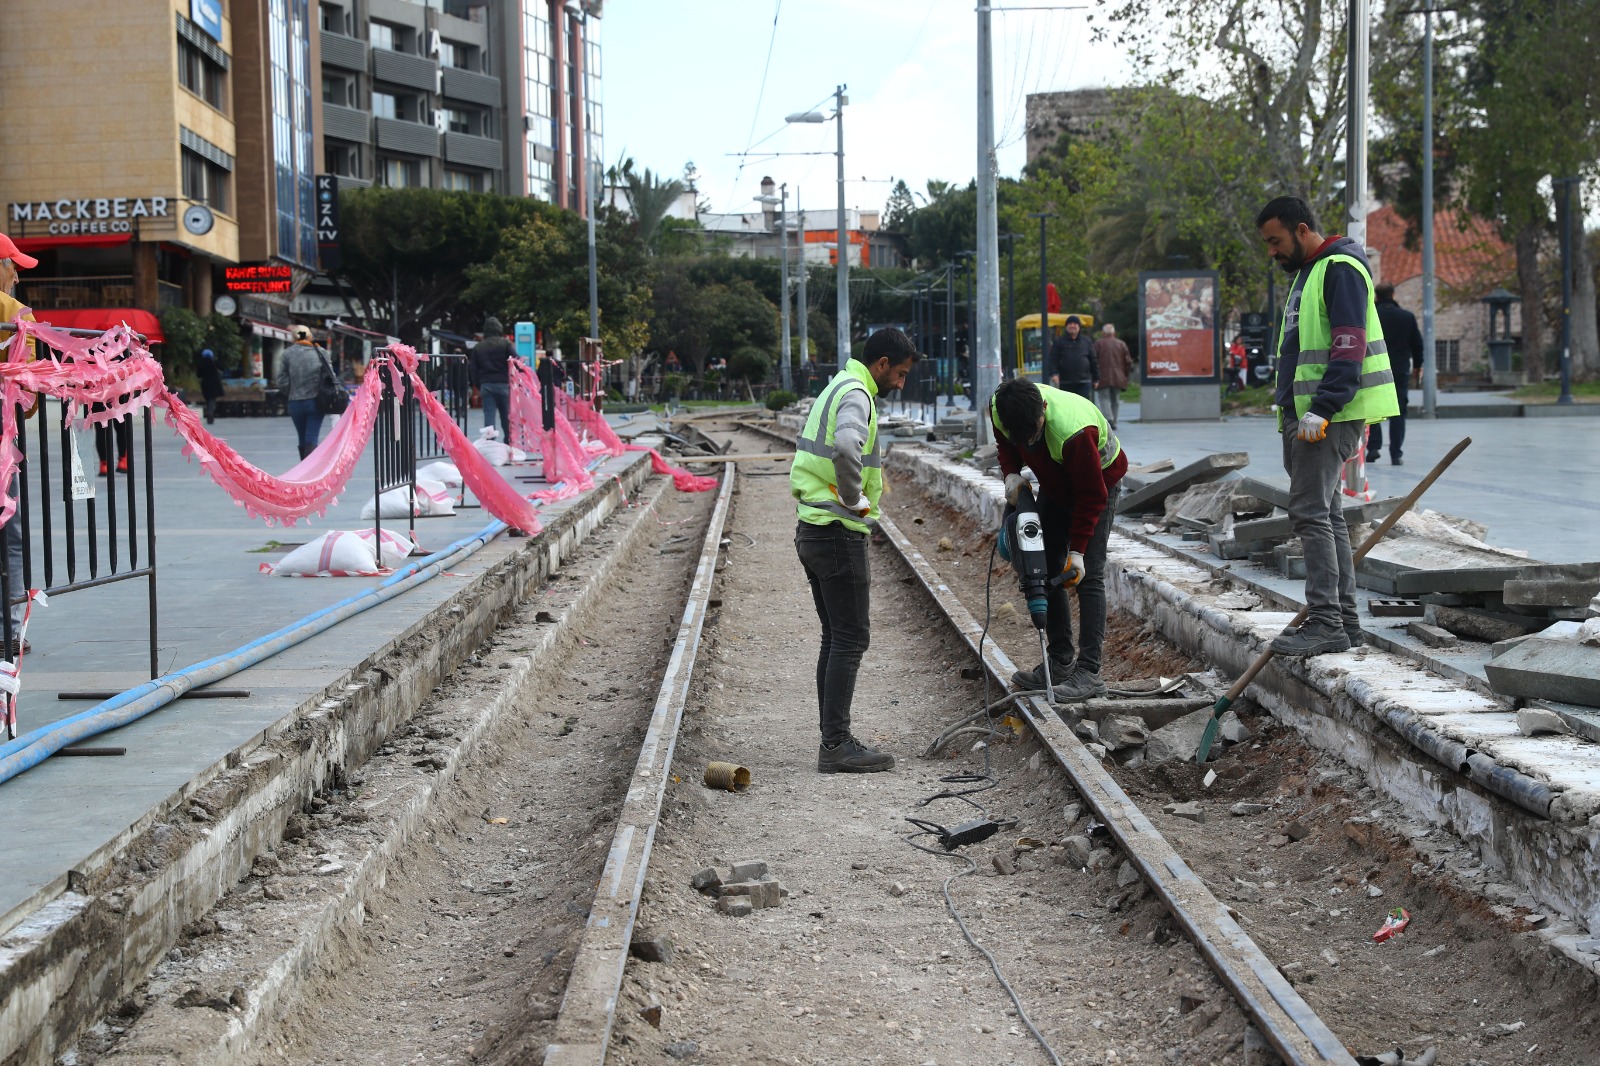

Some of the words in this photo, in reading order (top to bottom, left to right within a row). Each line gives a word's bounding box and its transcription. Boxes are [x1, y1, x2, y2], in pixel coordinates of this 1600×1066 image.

[13, 196, 168, 221] MACKBEAR
[49, 221, 108, 234] COFFEE
[317, 230, 338, 240] TV
